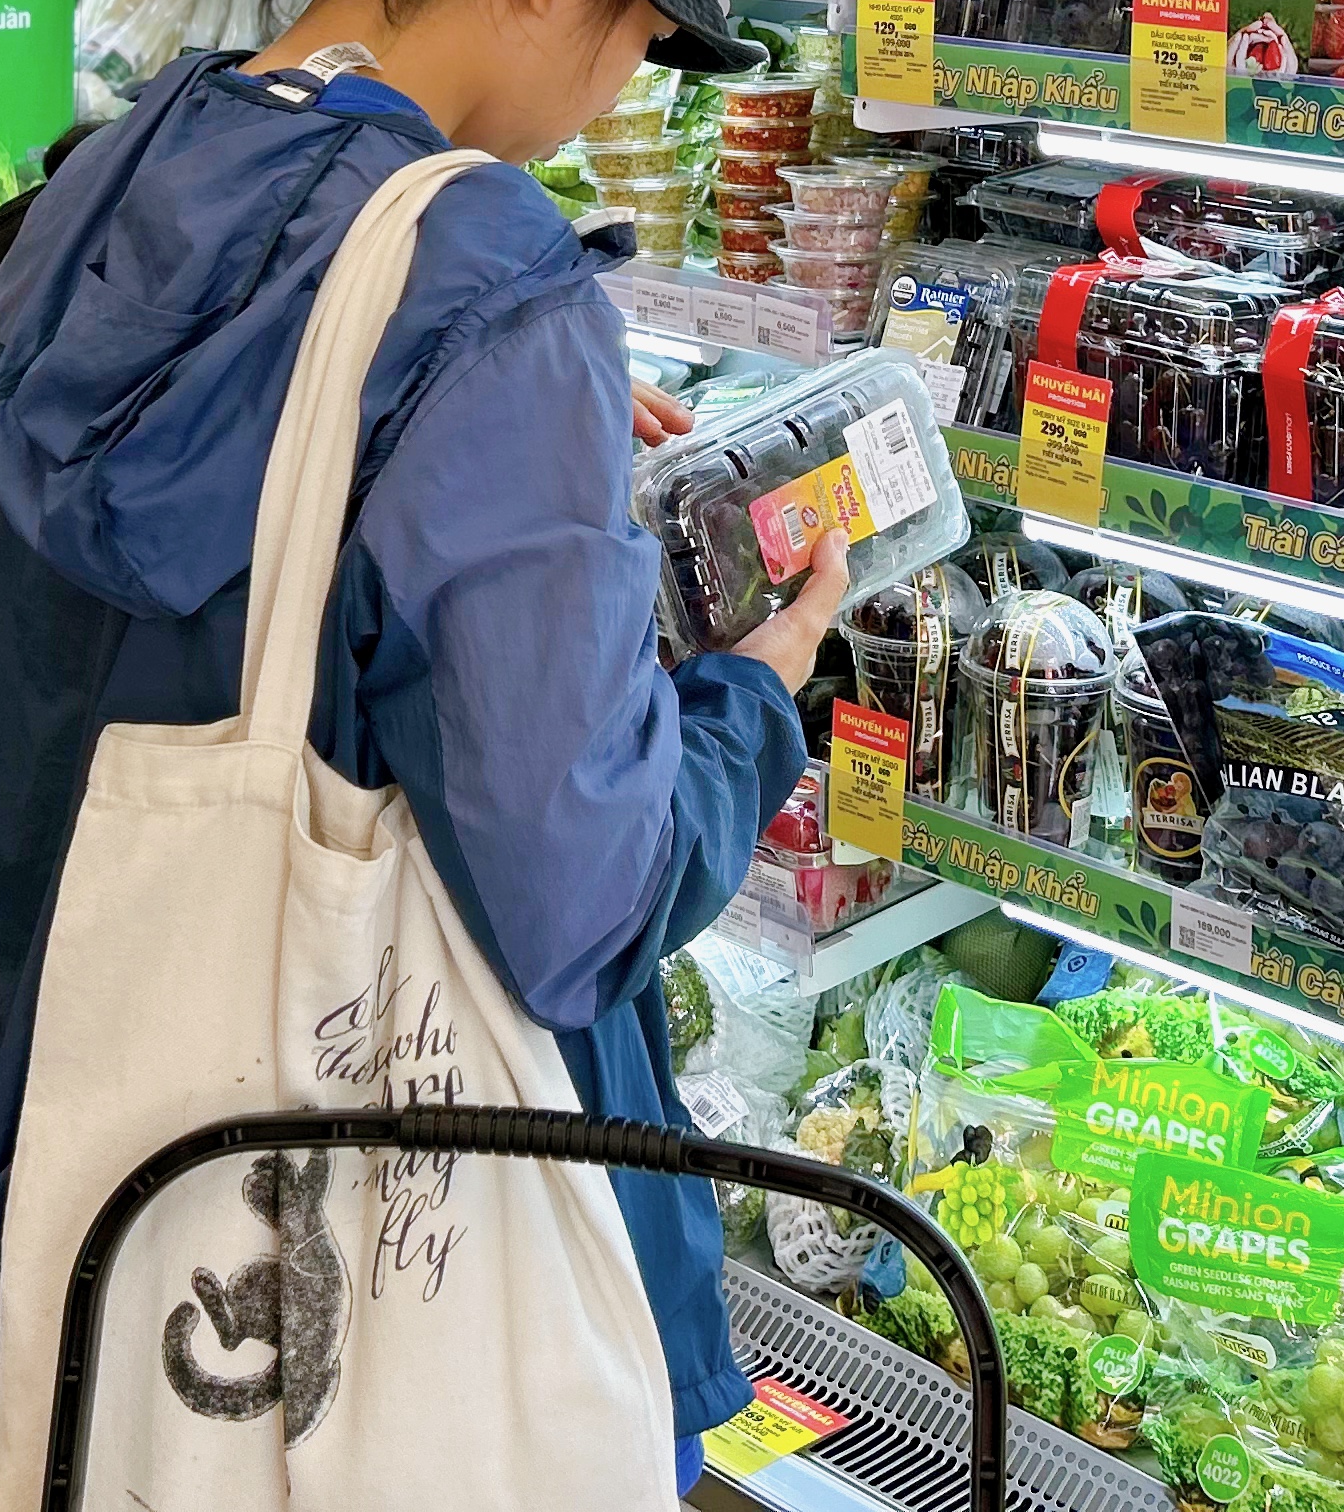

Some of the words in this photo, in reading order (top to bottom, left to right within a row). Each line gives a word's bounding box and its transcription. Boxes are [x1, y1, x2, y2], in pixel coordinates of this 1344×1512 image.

[966, 64, 1039, 109] Nhập
[1043, 68, 1120, 114] Khẩu
[1256, 95, 1320, 140] Trái
[920, 288, 966, 305] Rainier
[1032, 374, 1080, 398] KHUYẾN
[1082, 385, 1106, 404] MÃI
[1244, 513, 1307, 560] Trái
[929, 623, 940, 666] TERRISA
[839, 711, 883, 733] KHUYẾN
[884, 726, 905, 743] MÃI
[922, 707, 934, 745] TERRISA
[1005, 708, 1014, 748] TERRISA
[1148, 812, 1195, 829] TERRISA
[947, 836, 1022, 891] Nhập
[1024, 862, 1102, 918] Khẩu
[1092, 1061, 1231, 1133] Minion
[1085, 1101, 1226, 1165] GRAPES
[1161, 1175, 1312, 1237] Minion
[1157, 1217, 1310, 1274] GRAPES
[1202, 1462, 1243, 1488] 4022
